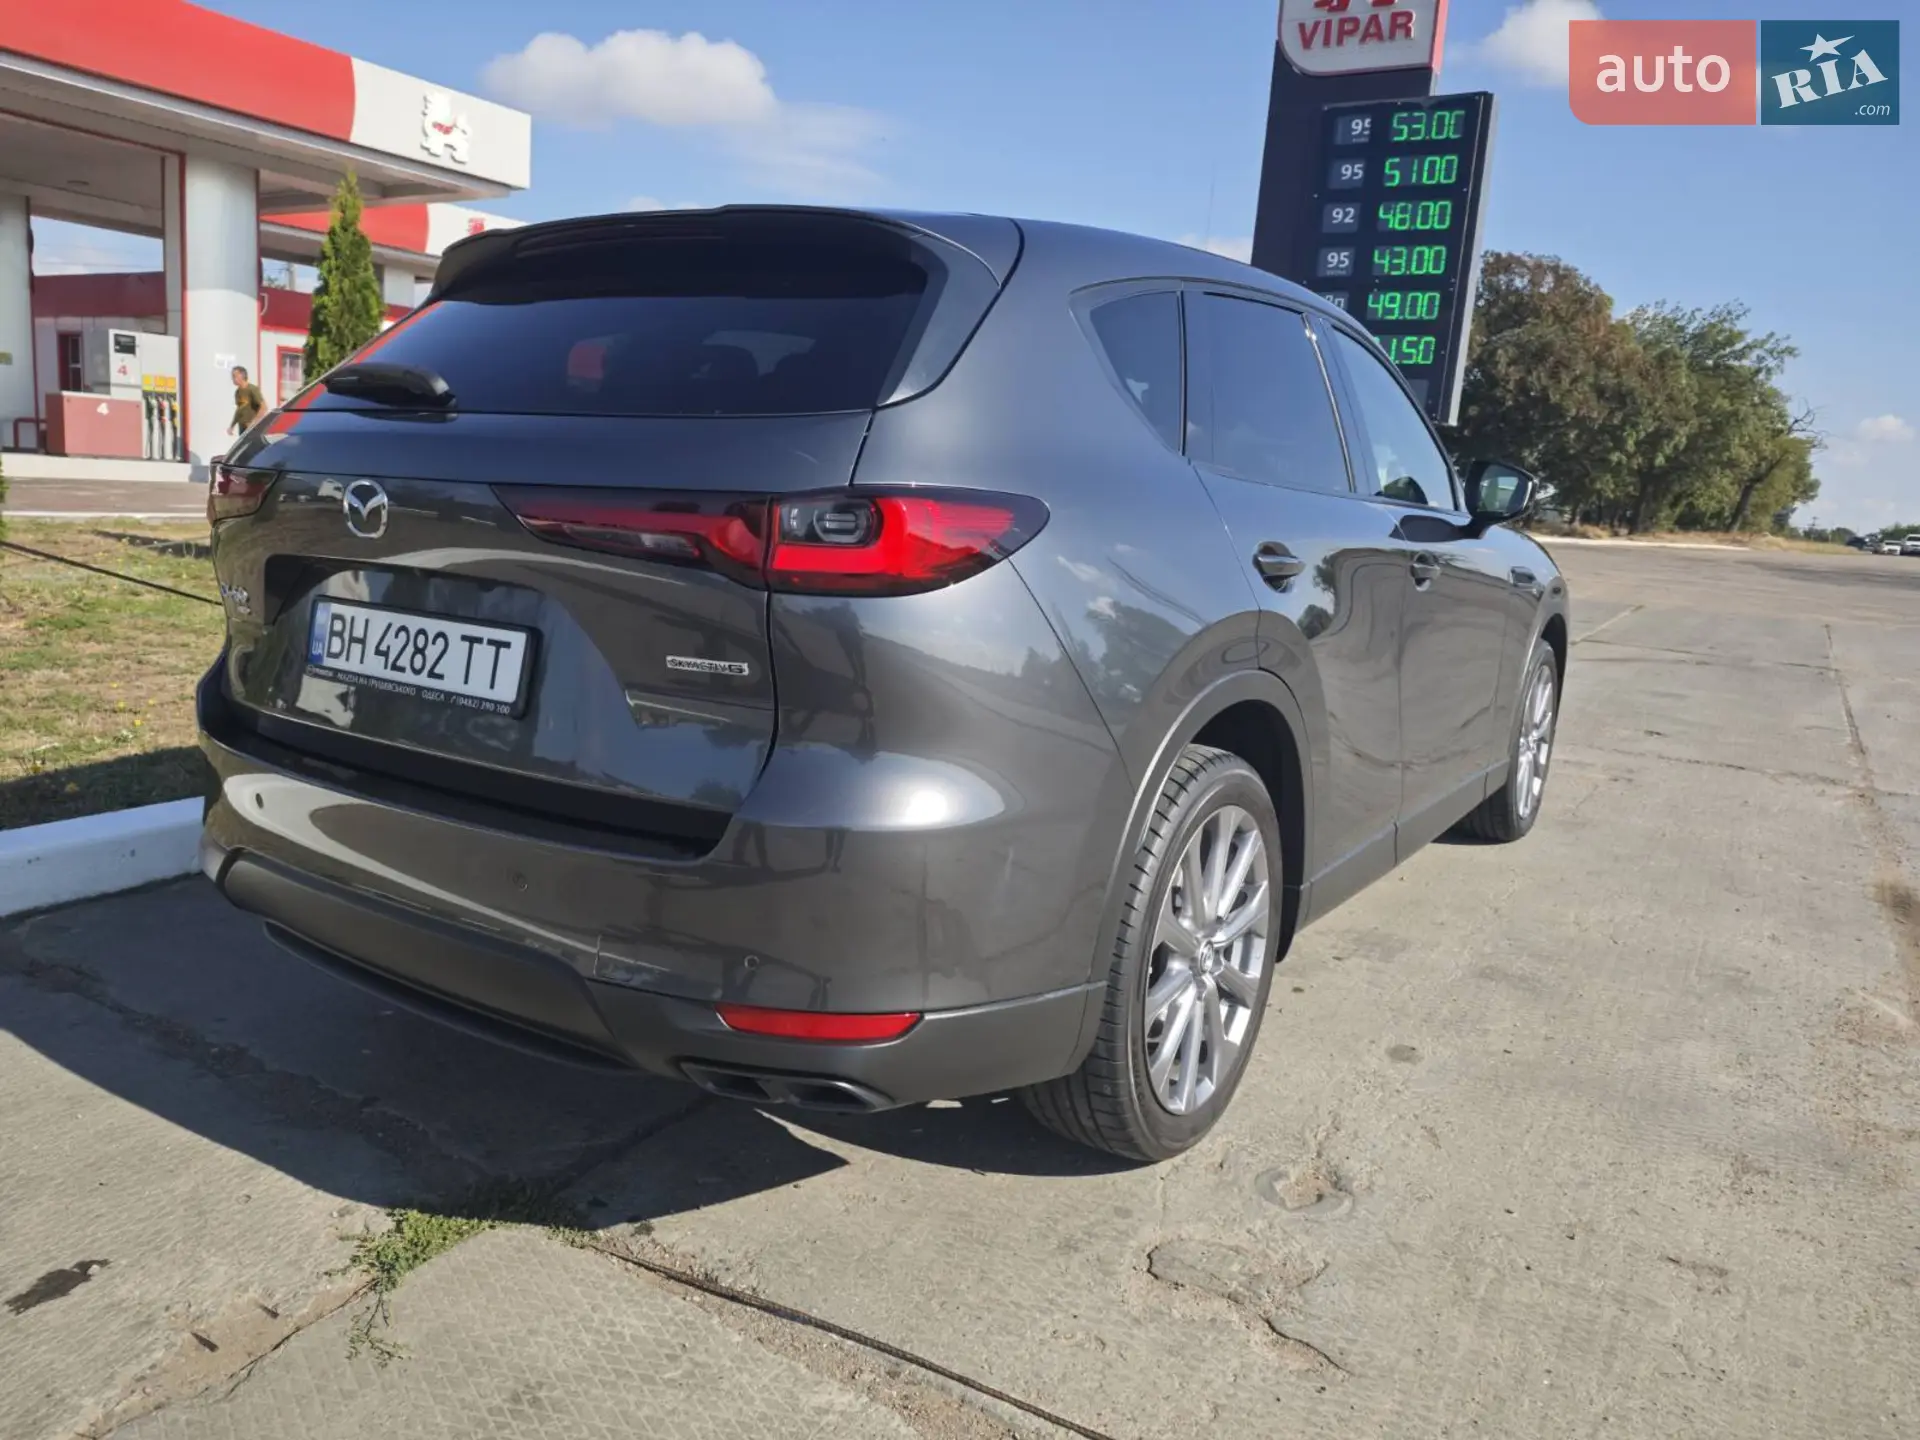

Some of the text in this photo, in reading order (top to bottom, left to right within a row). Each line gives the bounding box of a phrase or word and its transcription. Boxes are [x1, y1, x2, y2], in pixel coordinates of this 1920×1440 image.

[1298, 10, 1416, 50] VIPAR
[1341, 163, 1364, 180] 95
[1332, 207, 1355, 224] 92
[1327, 246, 1447, 275] 95 43.00
[1367, 292, 1441, 320] 49.00
[1374, 335, 1436, 365] 1.50
[311, 641, 323, 656] UA
[326, 612, 512, 690] BH 4282 TT
